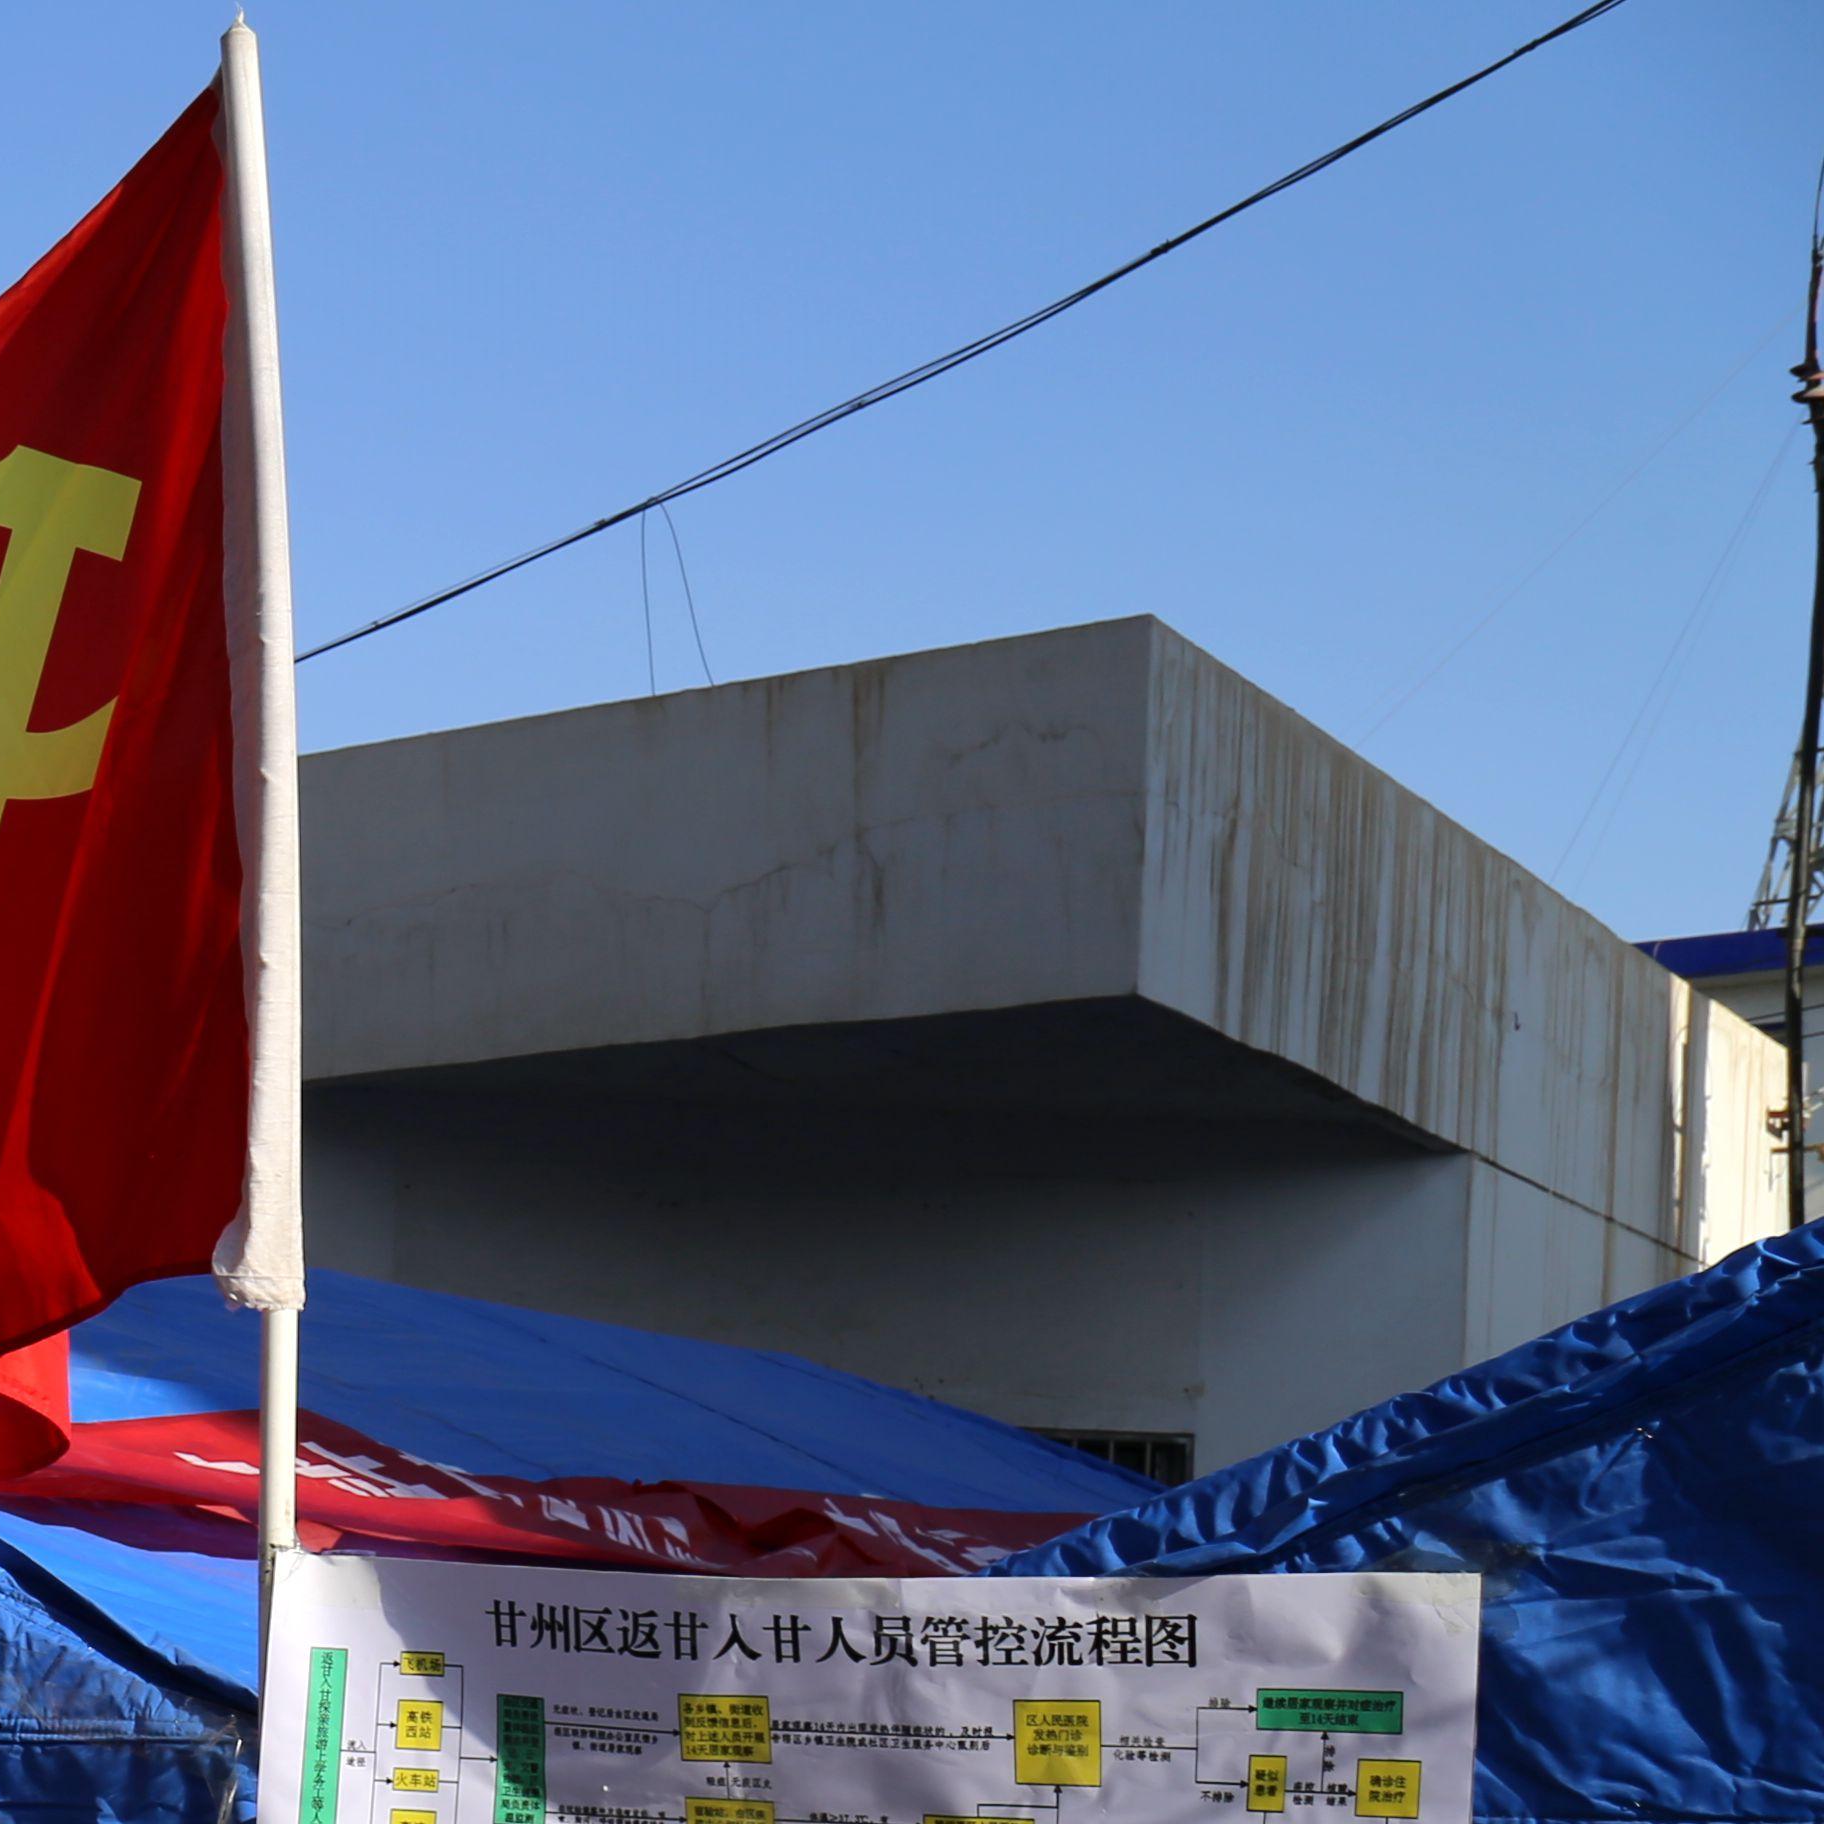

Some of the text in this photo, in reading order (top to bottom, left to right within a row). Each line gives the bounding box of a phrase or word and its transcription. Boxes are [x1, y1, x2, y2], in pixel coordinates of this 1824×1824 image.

[484, 1598, 1198, 1669] 甘州区返甘入甘人员管控流程图
[403, 1657, 442, 1672] 飞机场
[406, 1710, 433, 1724] 高铁
[1026, 1714, 1091, 1728] 区人民医院
[405, 1726, 433, 1740] 西站
[1033, 1728, 1083, 1742] 发热门诊
[395, 1773, 437, 1788] 火车站
[1369, 1775, 1407, 1789] 确诊住
